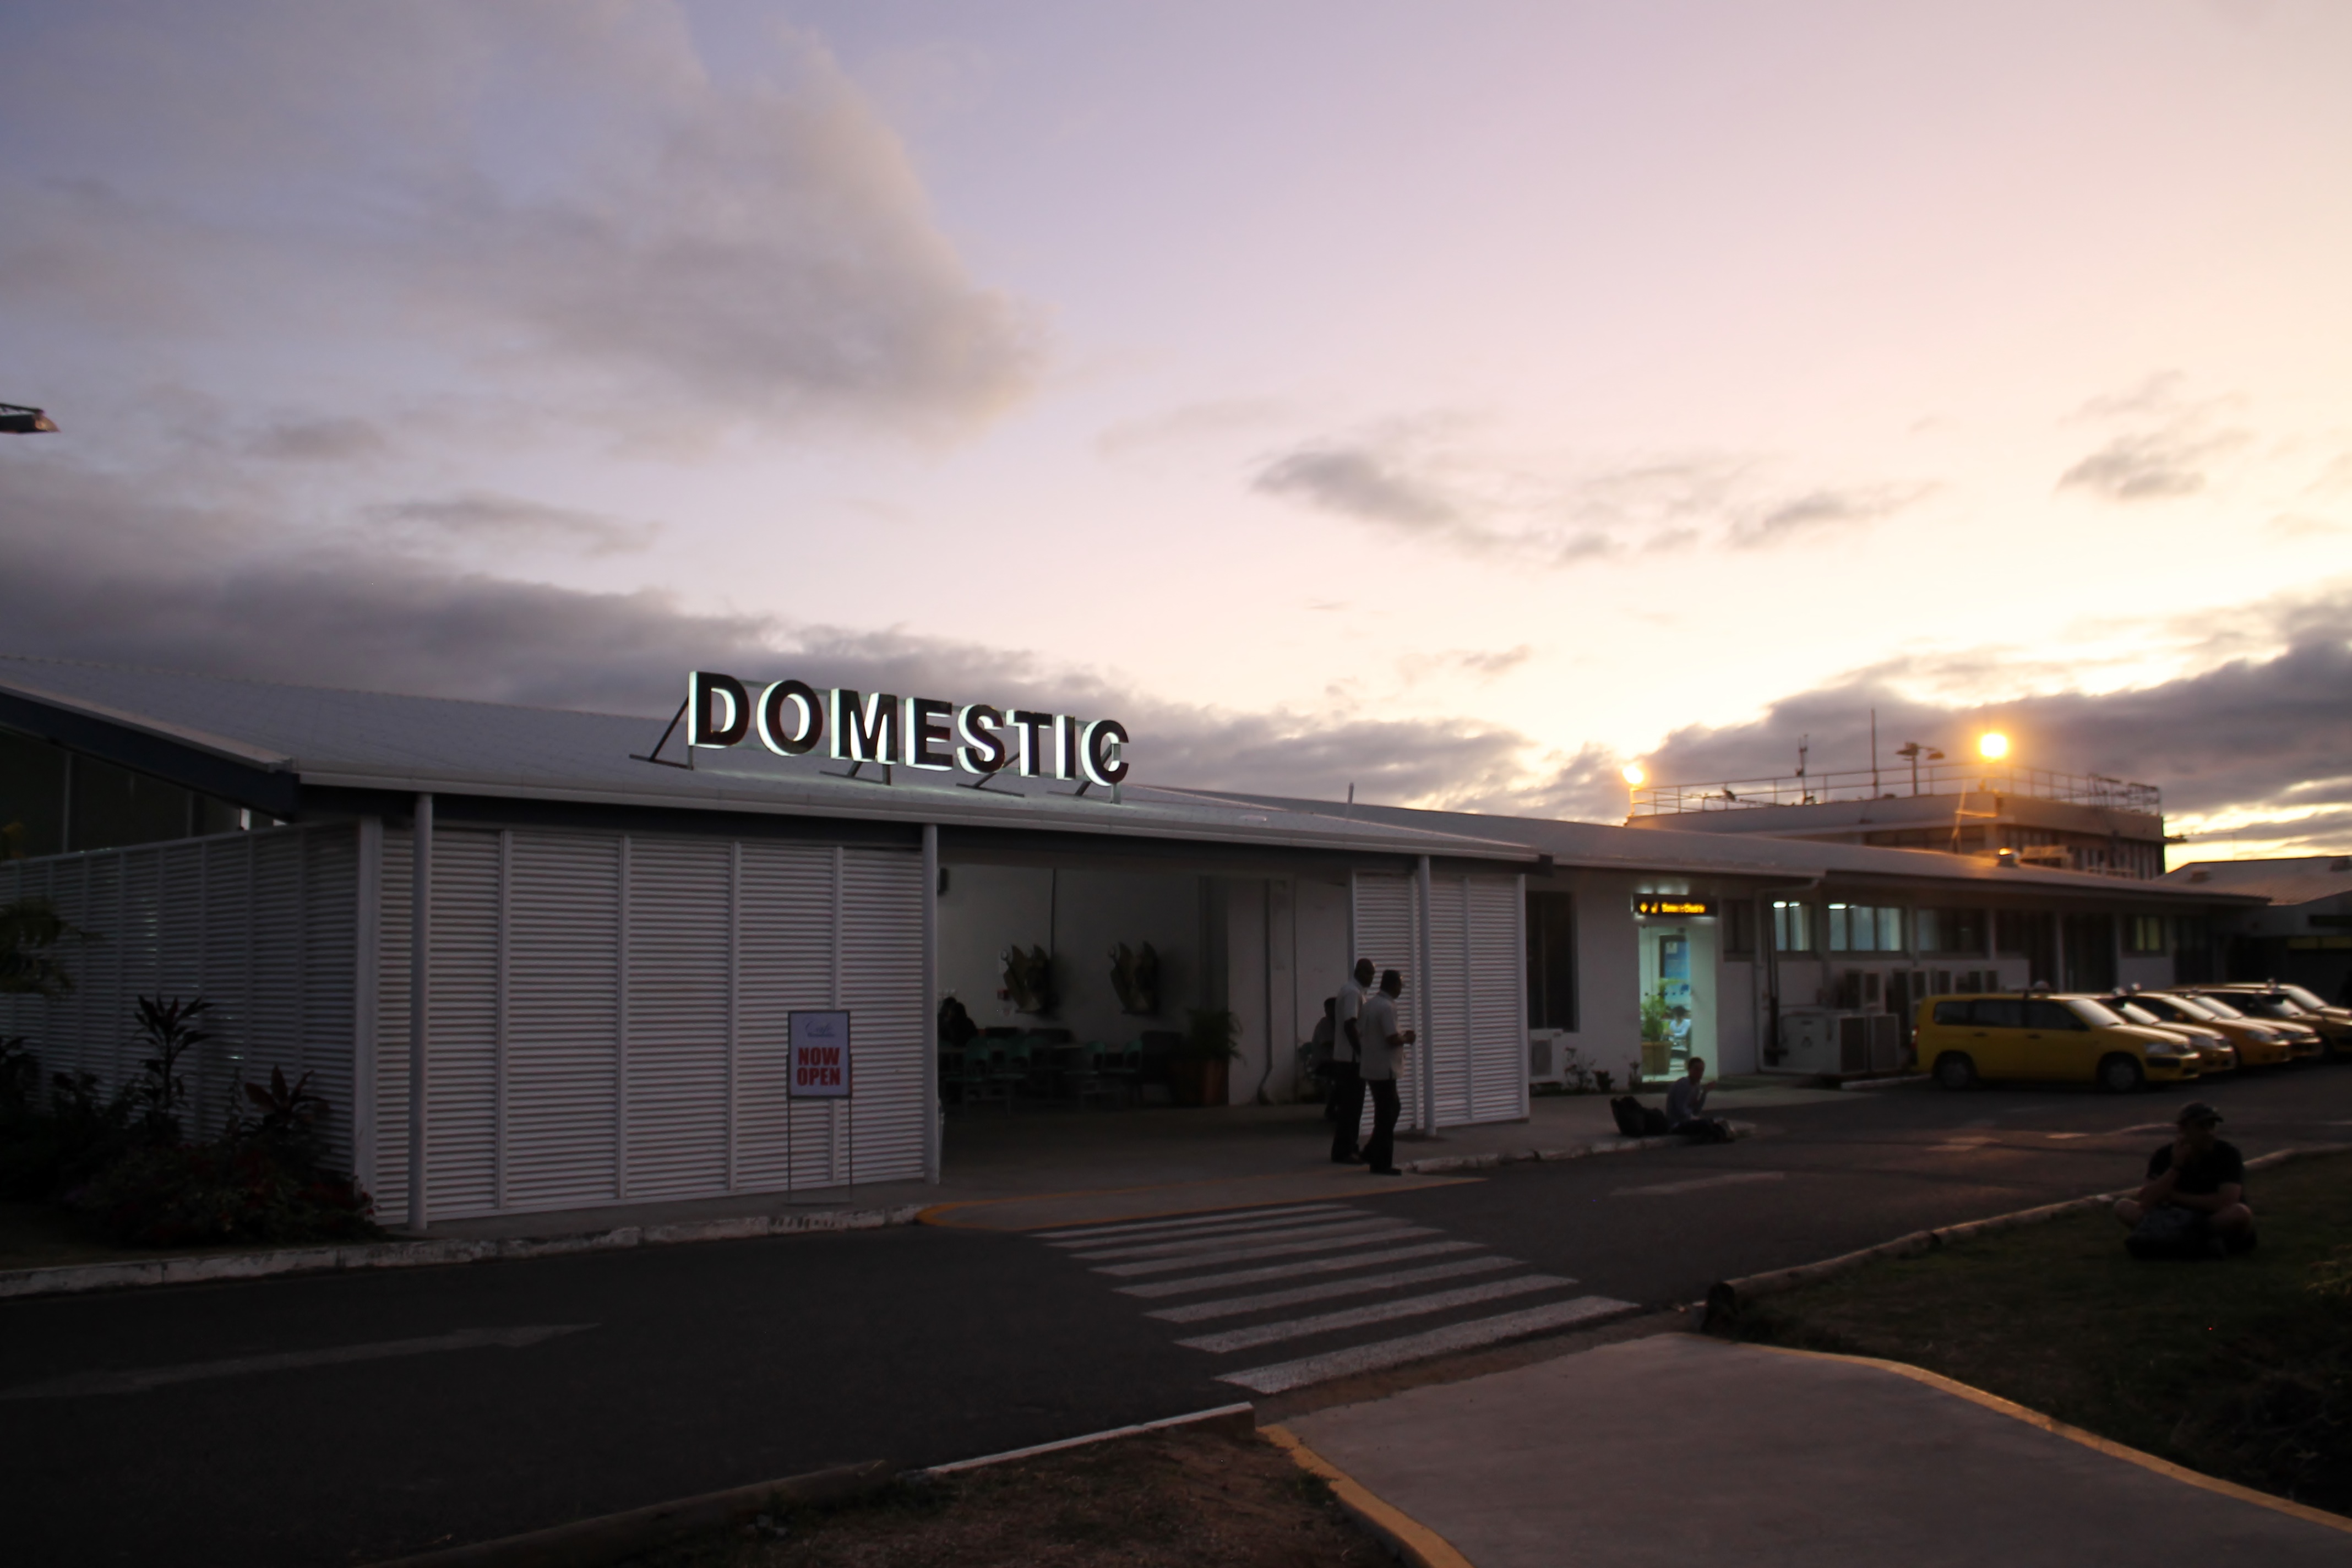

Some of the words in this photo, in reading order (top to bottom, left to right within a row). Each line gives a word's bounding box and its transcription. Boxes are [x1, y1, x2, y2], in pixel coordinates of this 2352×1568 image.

[688, 671, 1129, 787] DOMESTIC
[798, 1047, 840, 1066] NOW
[797, 1067, 841, 1086] OPEN
